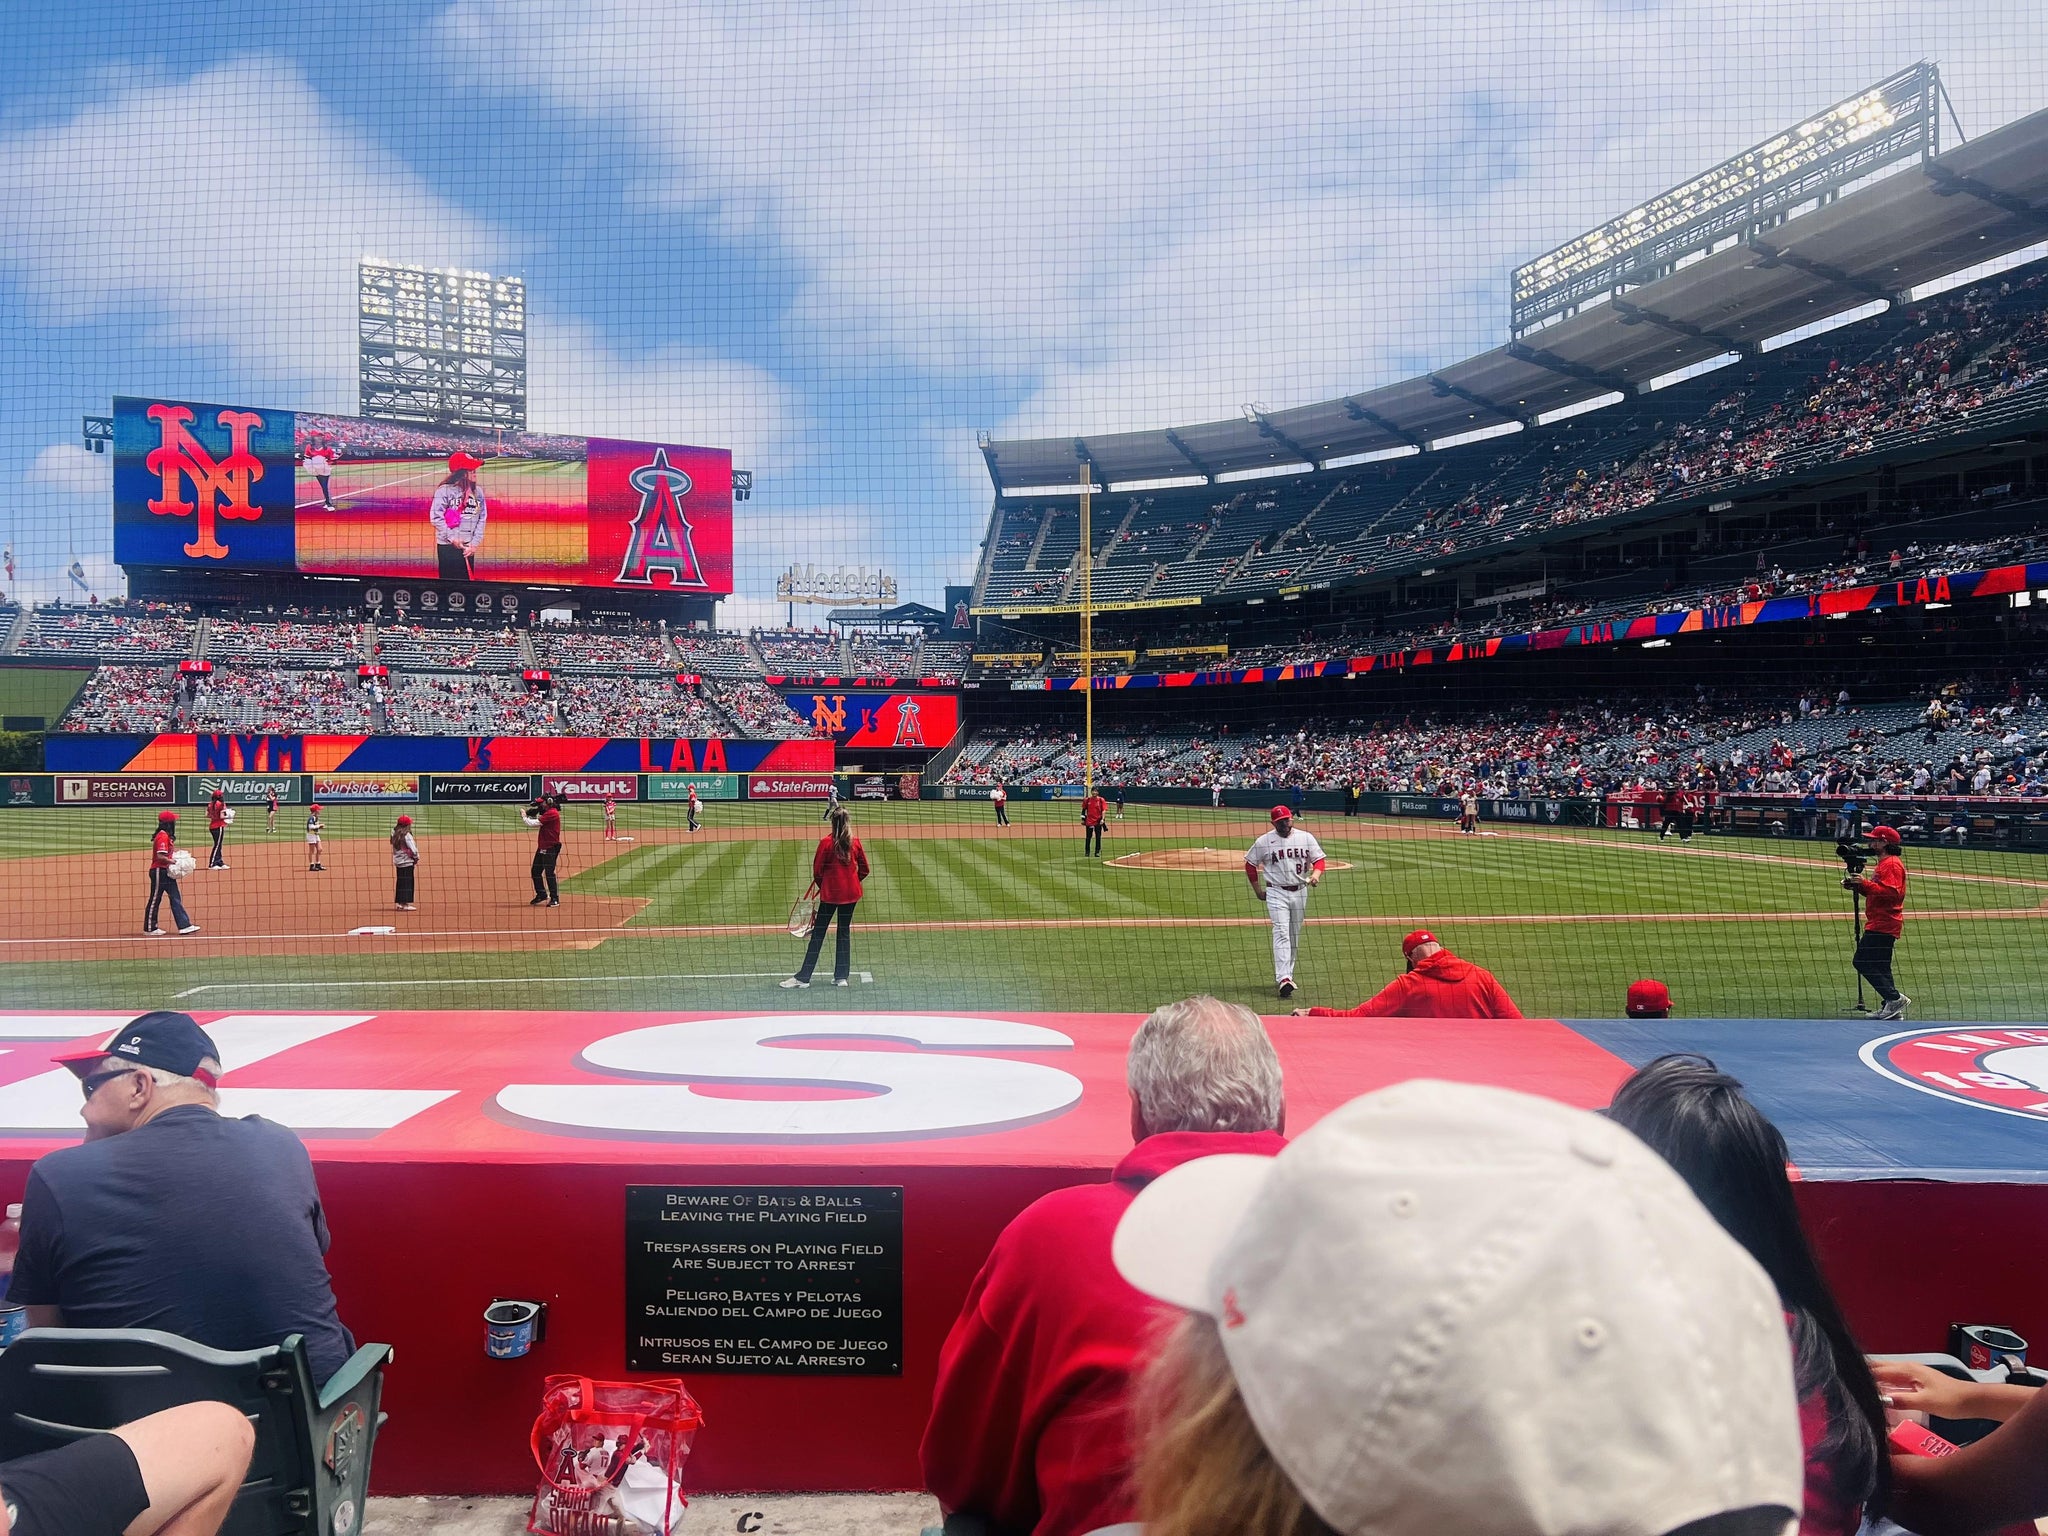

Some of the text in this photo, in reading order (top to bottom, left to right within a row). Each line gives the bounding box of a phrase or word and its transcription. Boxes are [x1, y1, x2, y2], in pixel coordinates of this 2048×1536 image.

[793, 562, 880, 593] Modelo
[1897, 575, 1951, 606] LAA
[1580, 622, 1614, 645] LAA
[198, 735, 302, 771] NYM
[640, 738, 728, 772] LAA
[93, 782, 166, 791] PECHANGA
[319, 779, 380, 796] Surfside
[435, 782, 528, 793] NITTO TIRE.COM
[549, 780, 630, 795] Yakult
[1502, 802, 1527, 817] Modelo
[1271, 848, 1310, 865] ANGELS
[666, 1194, 862, 1207] BEWARE OF BATS & BALLS
[660, 1210, 867, 1223] LEAVING THE PLAYING FIELD
[643, 1241, 884, 1255] TRESPASSERS ON PLAYING FIELD
[672, 1258, 855, 1271] ARE SUBJECT TO ARREST
[666, 1289, 861, 1304] PELIGRO, BATES Y PELOTAS
[645, 1304, 882, 1319] SALIENDO DEL CAMPO DE JUEGO
[640, 1336, 888, 1350] INTRUSOS EN EL CAMPO DE JUEGO
[662, 1352, 865, 1366] SERAN SUJETO AL ARRESTO
[737, 1512, 764, 1533] C
